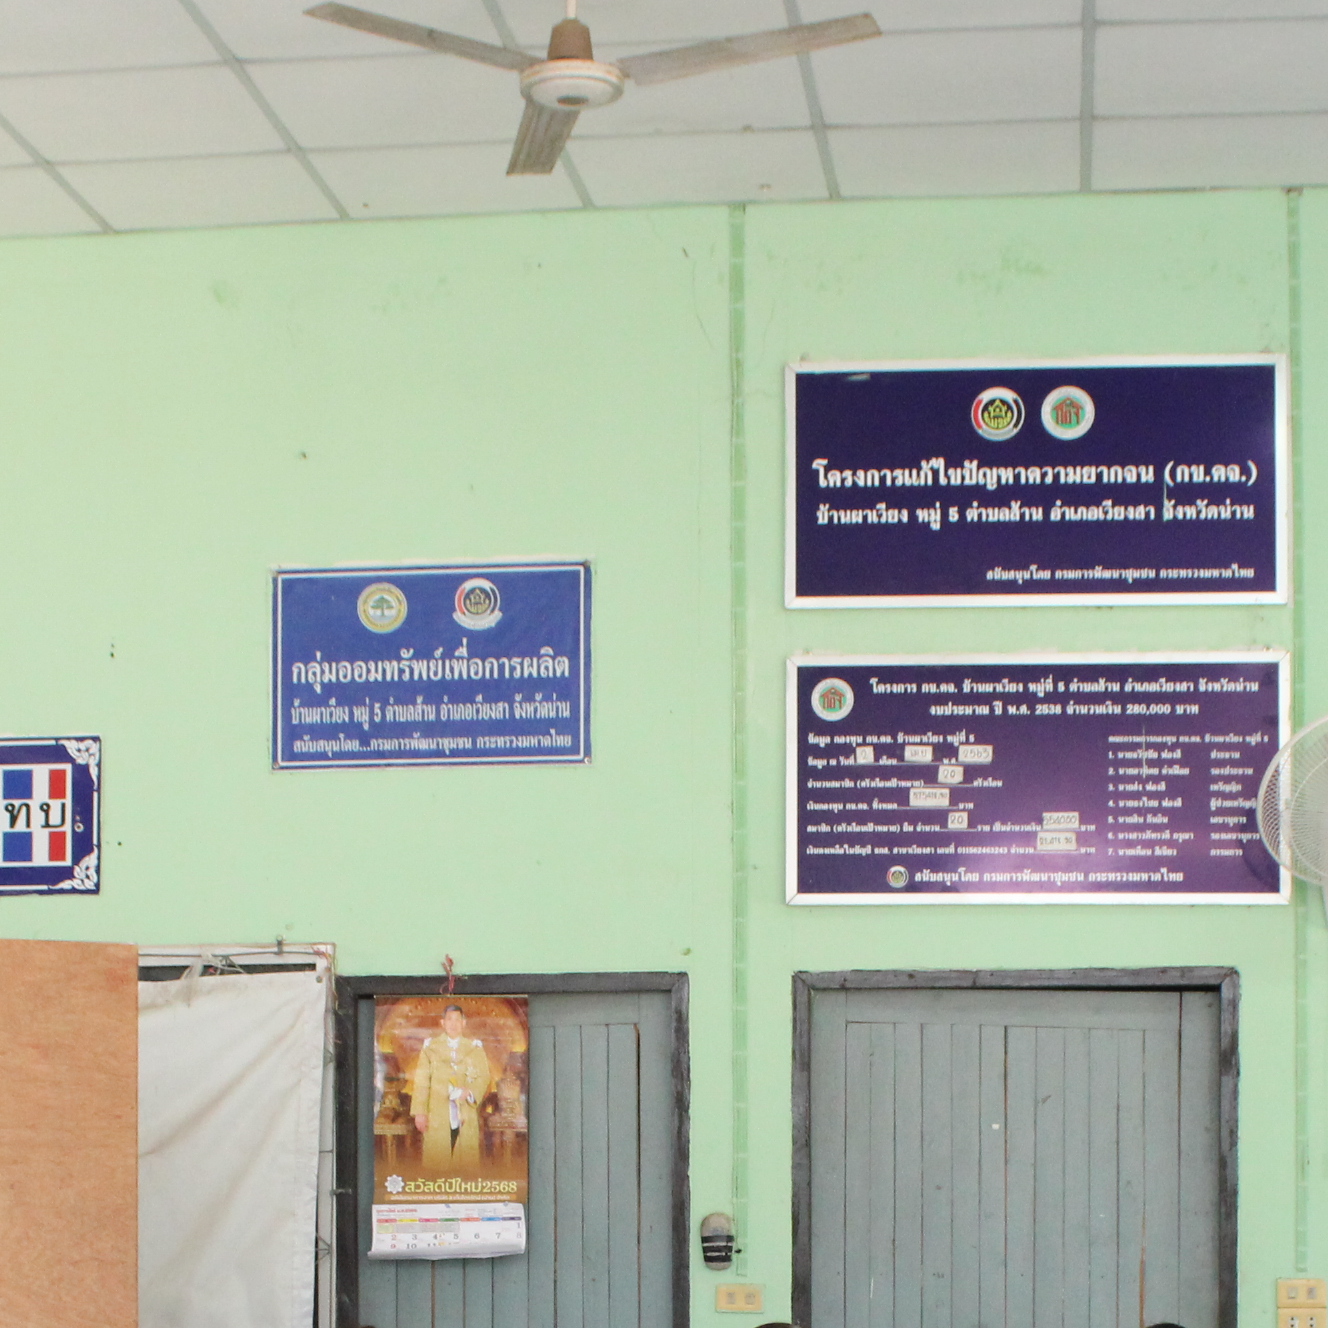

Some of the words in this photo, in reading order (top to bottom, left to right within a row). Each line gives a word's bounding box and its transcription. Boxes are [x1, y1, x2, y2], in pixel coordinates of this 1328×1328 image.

[812, 457, 1154, 491] โครงการแก้ไขปัญหาความยากจน
[816, 502, 909, 524] บ้านผาเวียง
[916, 503, 942, 530] หมู่
[948, 508, 959, 523] 5
[966, 501, 1043, 522] ตำบลส้าน
[1050, 499, 1155, 521] อำเภอเวียงสา
[1163, 499, 1255, 521] จังหวัดน่าน
[986, 565, 1051, 585] สนับสนุนโดย
[1055, 565, 1156, 583] กรมการพัฒนาชุมชน
[1159, 565, 1255, 580] กระทรวงมหาดไทย
[291, 637, 570, 694] กลุ่มออมทรัพย์เพื่อการผลิต
[290, 697, 349, 725] บ้านผาเวียง
[353, 698, 370, 730] หมู่
[374, 705, 382, 723] 5
[386, 696, 436, 723] ตำบลส้าน
[440, 695, 509, 721] อำเภอเวียงสา
[513, 692, 571, 720] จังหวัดน่าน
[1126, 703, 1171, 716] 280,000
[476, 728, 572, 749] กระทรวงมหาดไทย
[915, 866, 979, 888] สนับสนุนโดย
[983, 867, 1084, 888] กรมการพัฒนาชุมชน
[1088, 867, 1184, 884] กระทรวงมหาดไทย
